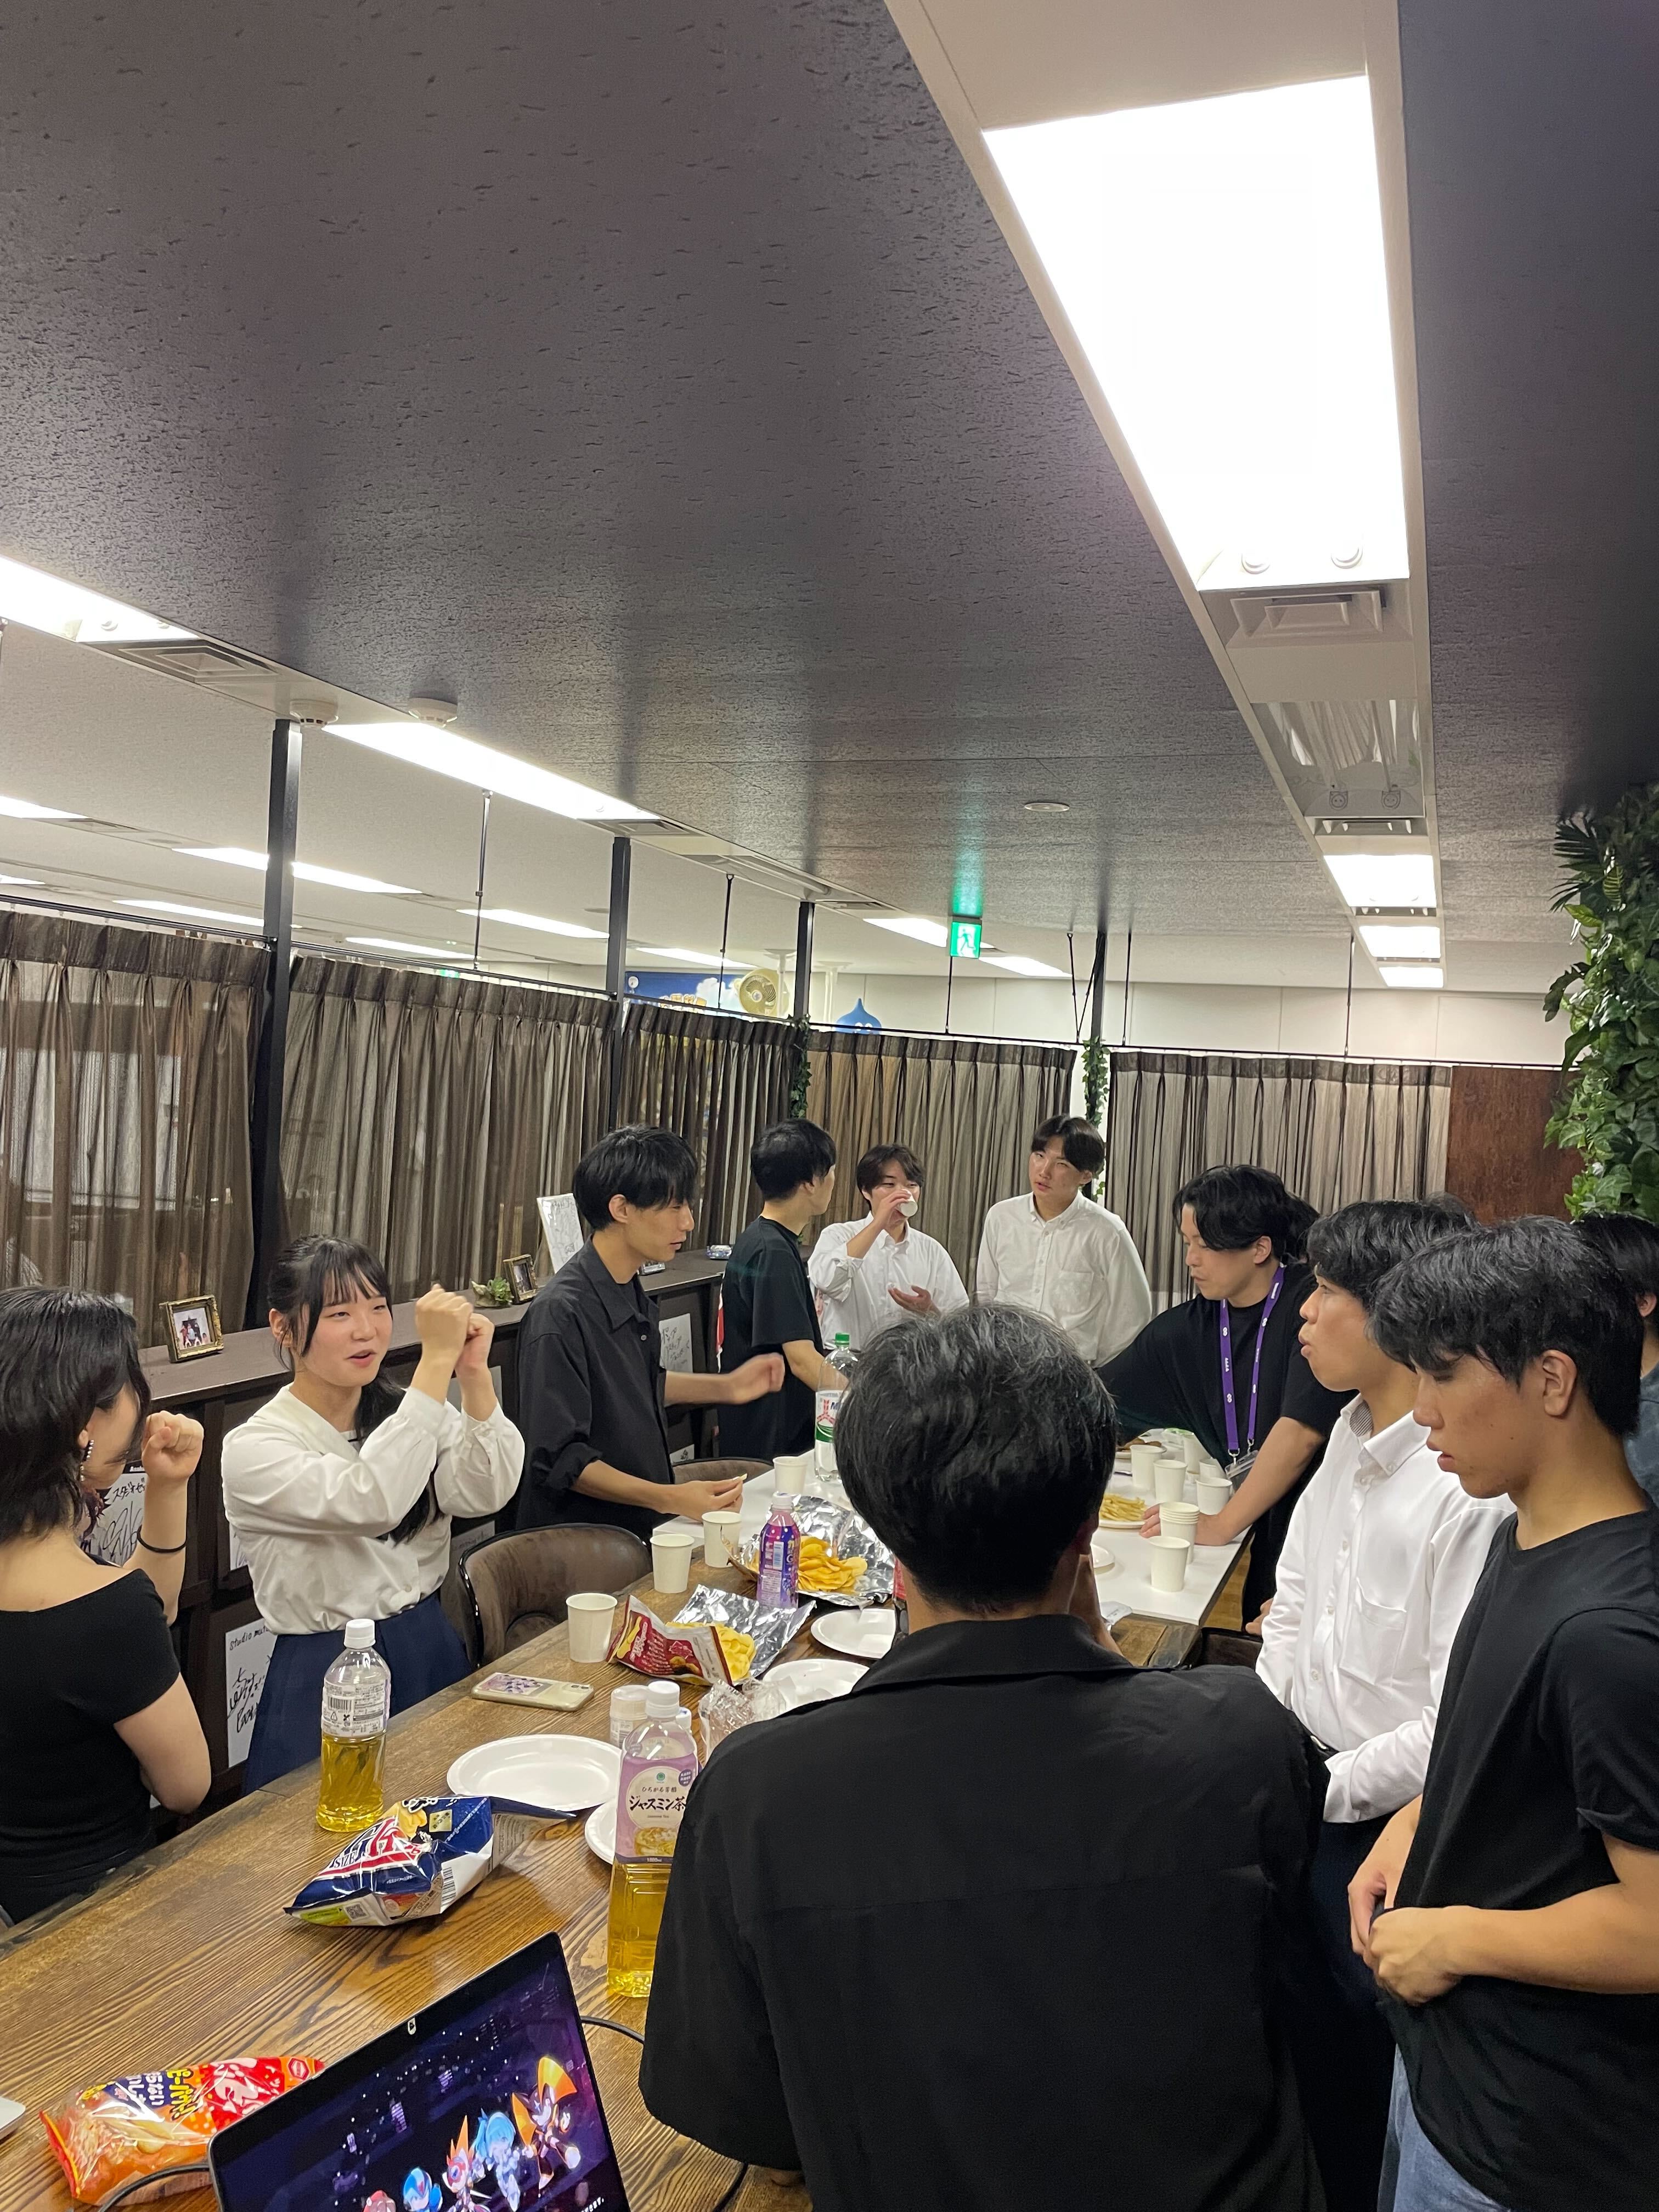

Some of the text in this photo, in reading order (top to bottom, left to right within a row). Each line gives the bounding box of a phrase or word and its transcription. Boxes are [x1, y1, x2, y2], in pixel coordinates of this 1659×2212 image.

[629, 1796, 686, 1812] ジャスミン茶
